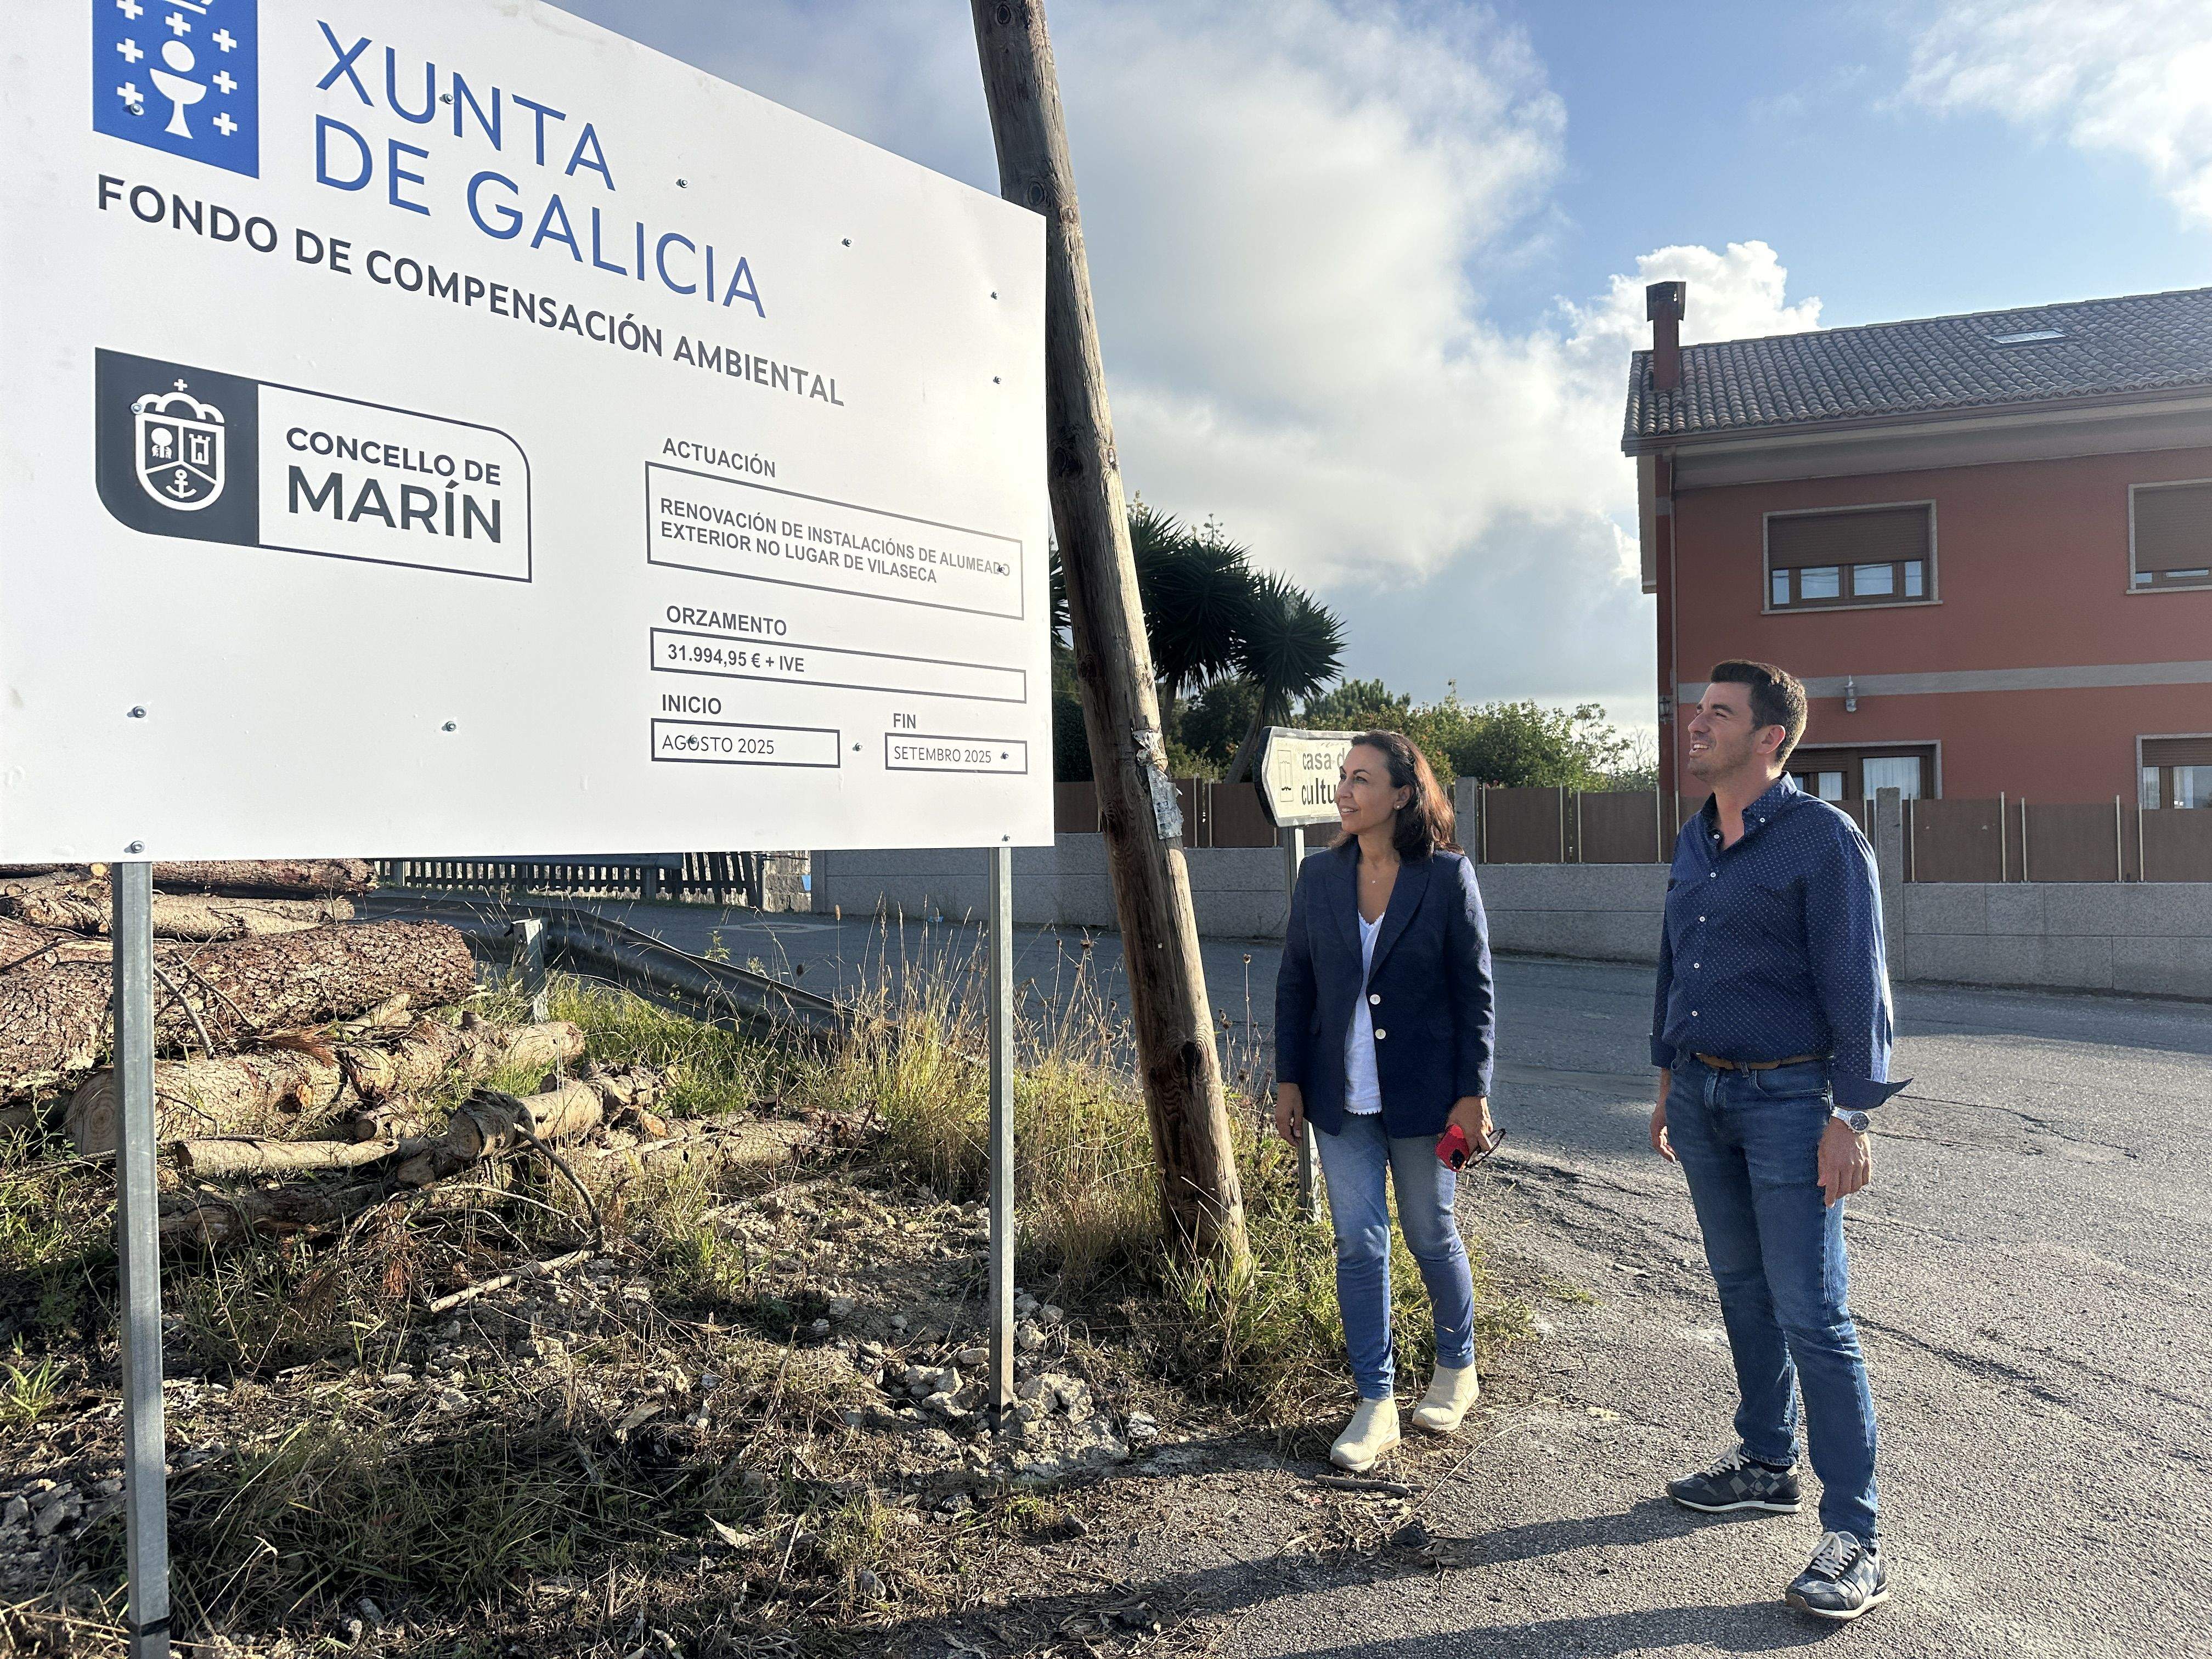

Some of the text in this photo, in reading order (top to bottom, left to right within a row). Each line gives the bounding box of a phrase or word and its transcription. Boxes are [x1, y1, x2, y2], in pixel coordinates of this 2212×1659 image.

[315, 20, 616, 191] XUNTA
[315, 114, 766, 318] DE GALICIA
[99, 174, 844, 407] FONDO DE COMPENSACIÓN AMBIENTAL
[286, 427, 500, 486] CONCELLO DE
[663, 438, 775, 477] ACTUACIÓN
[289, 465, 500, 543] MARÍN
[661, 498, 1011, 577] RENOVACIÓN DE INSTALACIÓNS DE ALUMEADO
[662, 521, 936, 583] EXTERIOR NO LUGAR DE VILASECA
[667, 606, 787, 635] ORZAMENTO
[668, 644, 805, 672] 31.994,95 € + IVE
[663, 694, 721, 714] INICIO
[894, 713, 916, 729] FIN
[662, 735, 774, 754] AGOSTO 2025
[894, 746, 991, 763] SETEMBRO 2025
[1302, 747, 1345, 770] casa d
[1301, 777, 1336, 805] cultu
